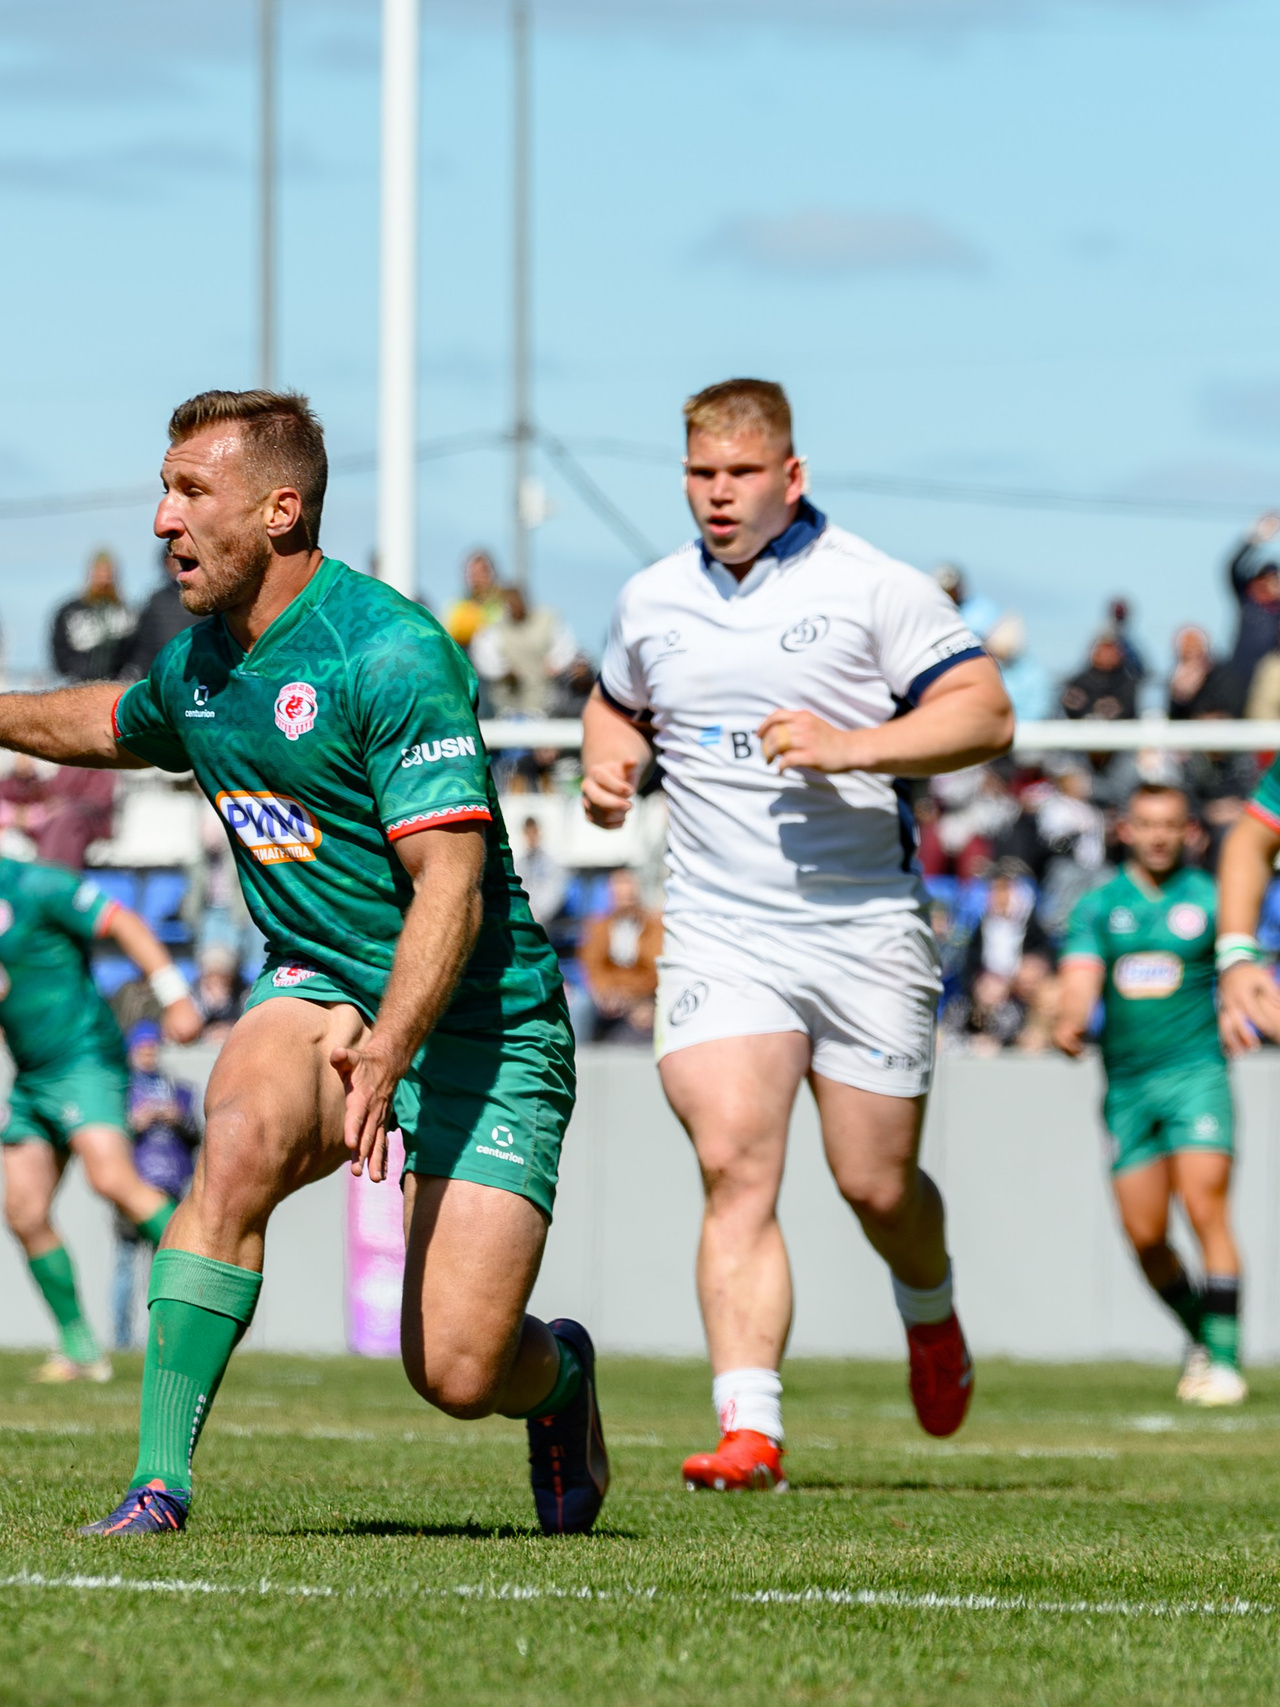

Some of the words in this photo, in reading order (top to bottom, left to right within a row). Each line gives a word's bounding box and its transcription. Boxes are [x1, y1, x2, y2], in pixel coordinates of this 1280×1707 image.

[421, 736, 476, 762] USN
[226, 803, 307, 838] РИМ
[475, 1144, 524, 1165] centurion
